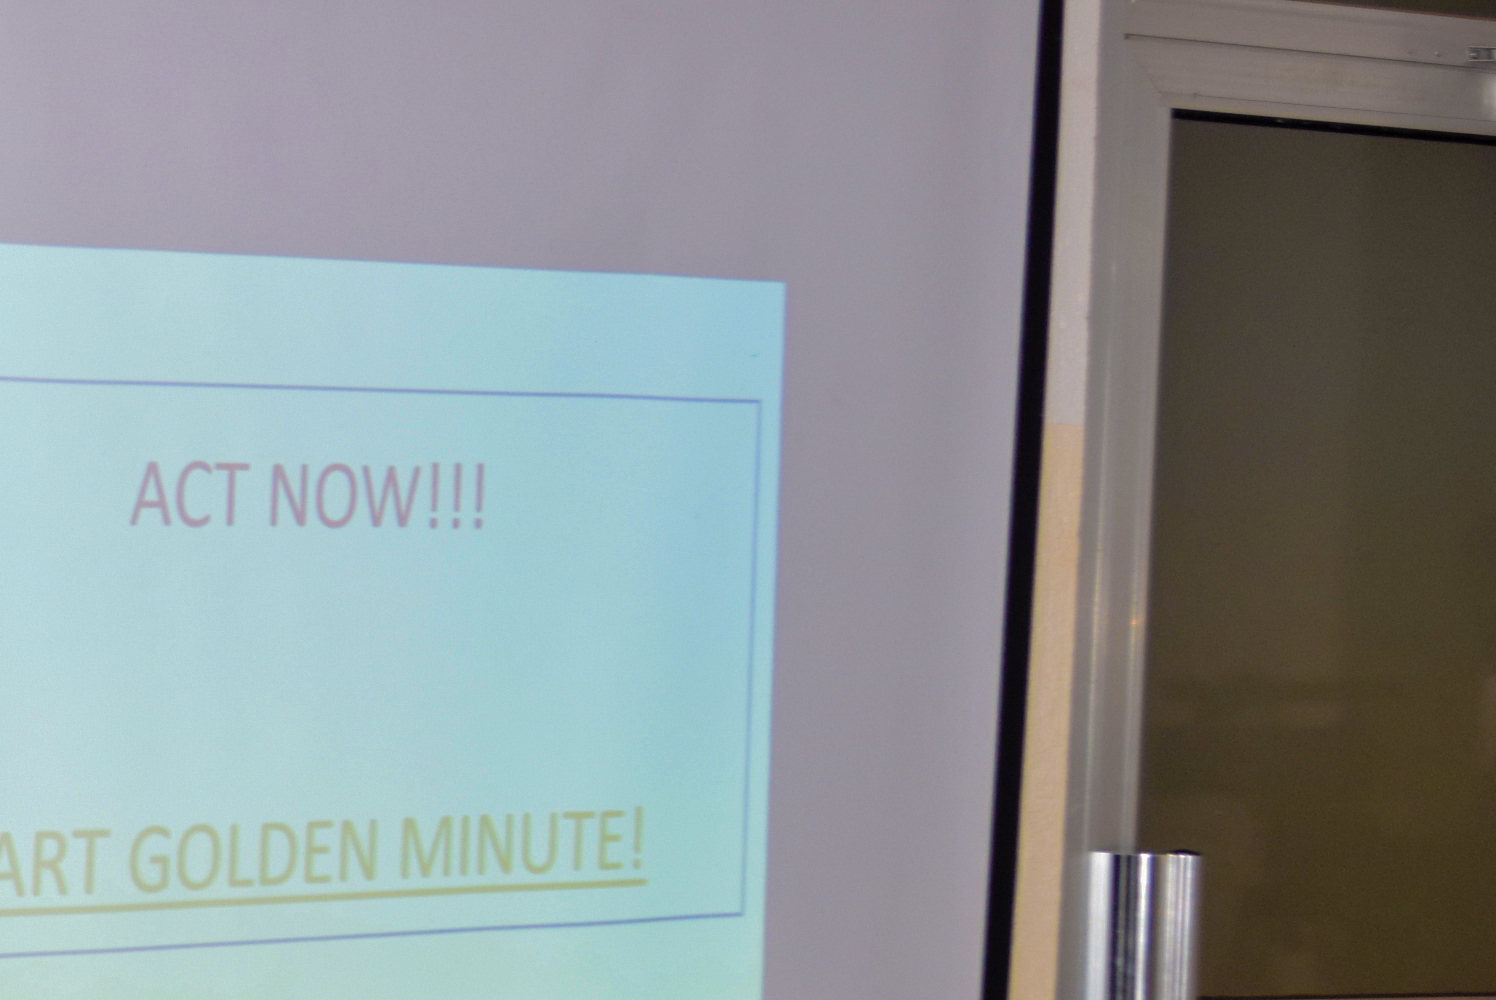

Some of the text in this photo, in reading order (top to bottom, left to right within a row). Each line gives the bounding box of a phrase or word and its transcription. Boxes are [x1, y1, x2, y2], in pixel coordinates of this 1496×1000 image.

[129, 460, 485, 530] ACT NOW!!!
[129, 818, 379, 893] GOLDEN
[400, 805, 645, 880] MINUTE!
